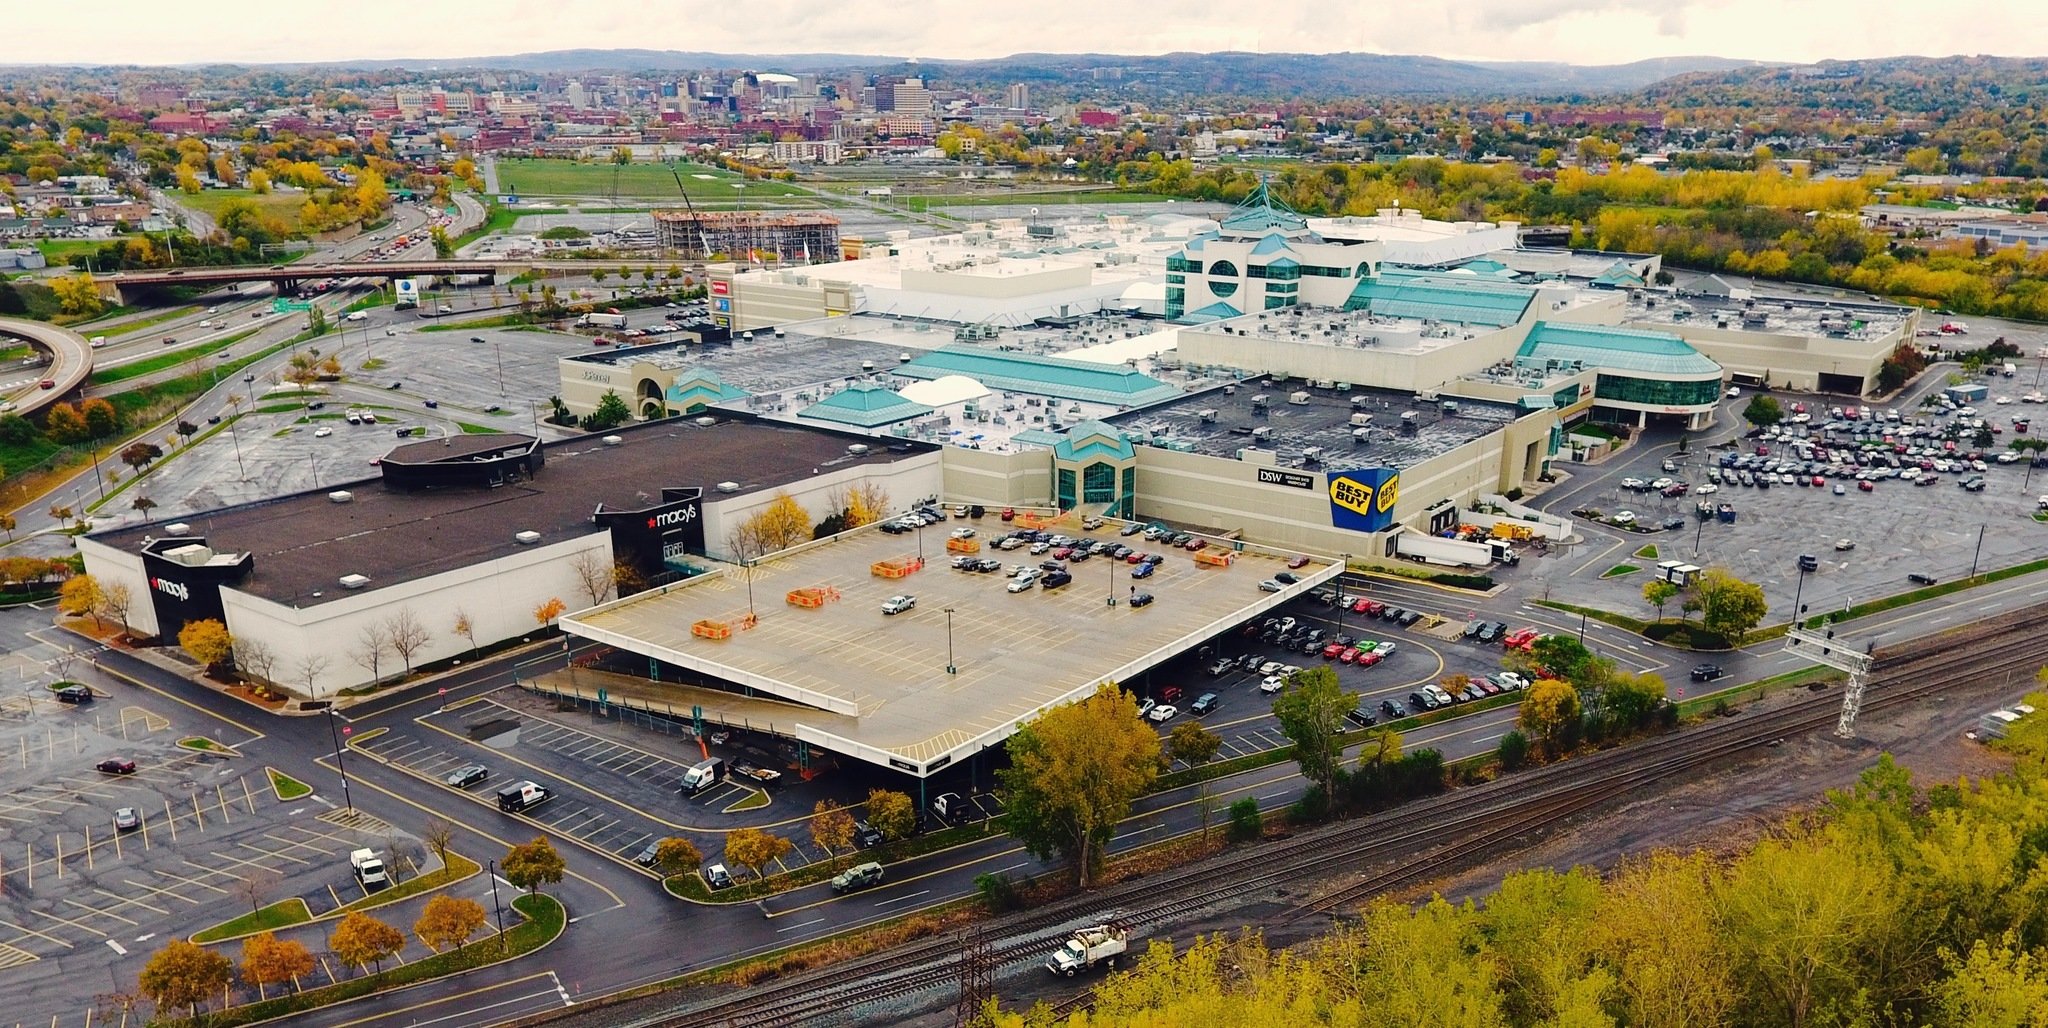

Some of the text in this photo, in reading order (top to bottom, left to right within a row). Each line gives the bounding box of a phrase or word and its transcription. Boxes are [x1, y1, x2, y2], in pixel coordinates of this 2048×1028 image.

[1260, 470, 1282, 482] DSW
[1335, 490, 1365, 508] BUY
[1336, 481, 1371, 501] BEST
[1380, 480, 1397, 499] BEST
[1380, 491, 1395, 509] BUY
[657, 504, 696, 527] macy's
[157, 578, 189, 602] macy's
